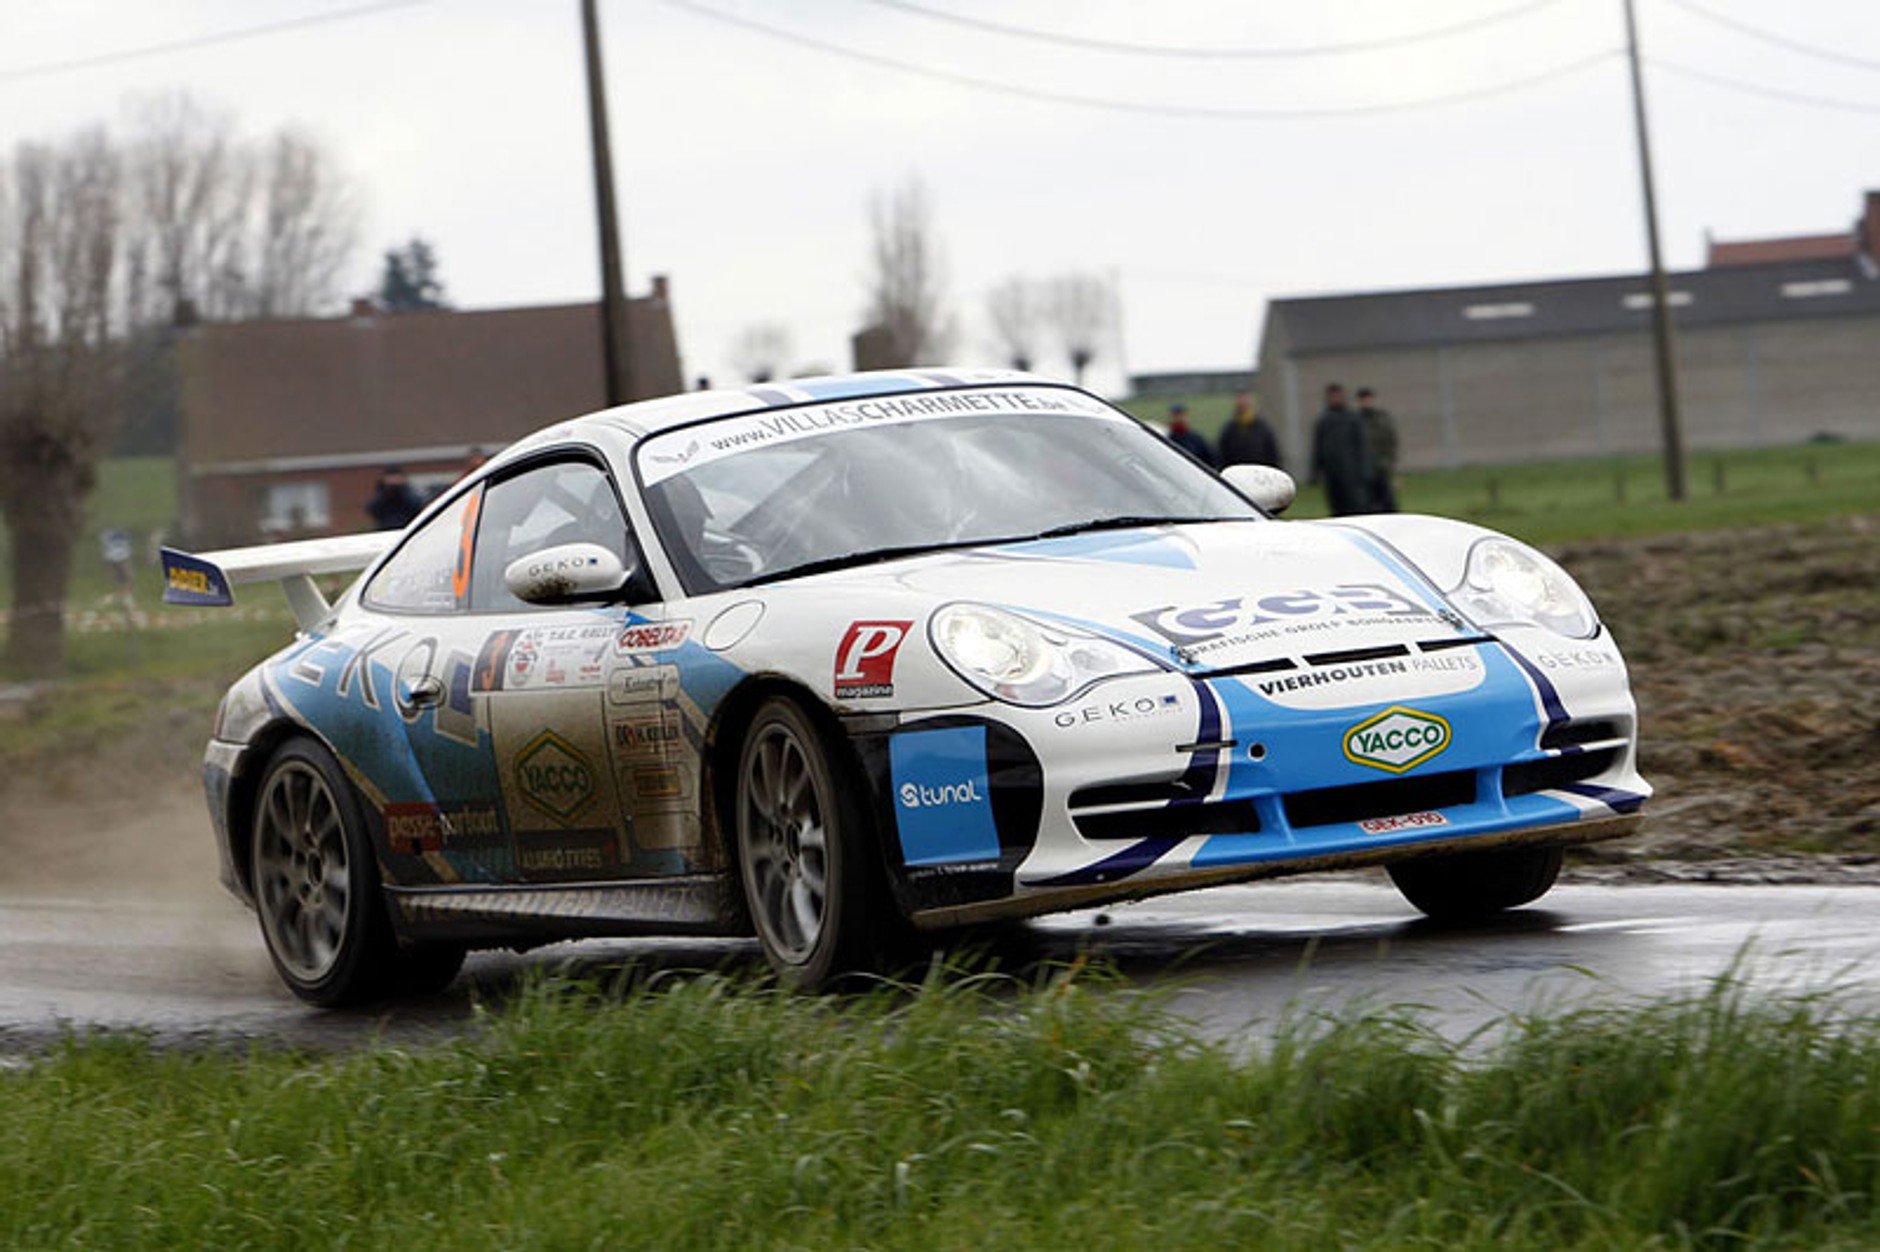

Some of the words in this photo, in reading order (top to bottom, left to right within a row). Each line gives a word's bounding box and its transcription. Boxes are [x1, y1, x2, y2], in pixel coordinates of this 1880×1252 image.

[836, 625, 903, 680] P
[837, 684, 892, 698] magazine
[1258, 661, 1407, 697] VIERHOUTEN
[1411, 656, 1478, 674] PALLETS
[1054, 697, 1155, 728] GEKO
[1356, 724, 1442, 754] YACCO
[524, 764, 589, 794] YACCO
